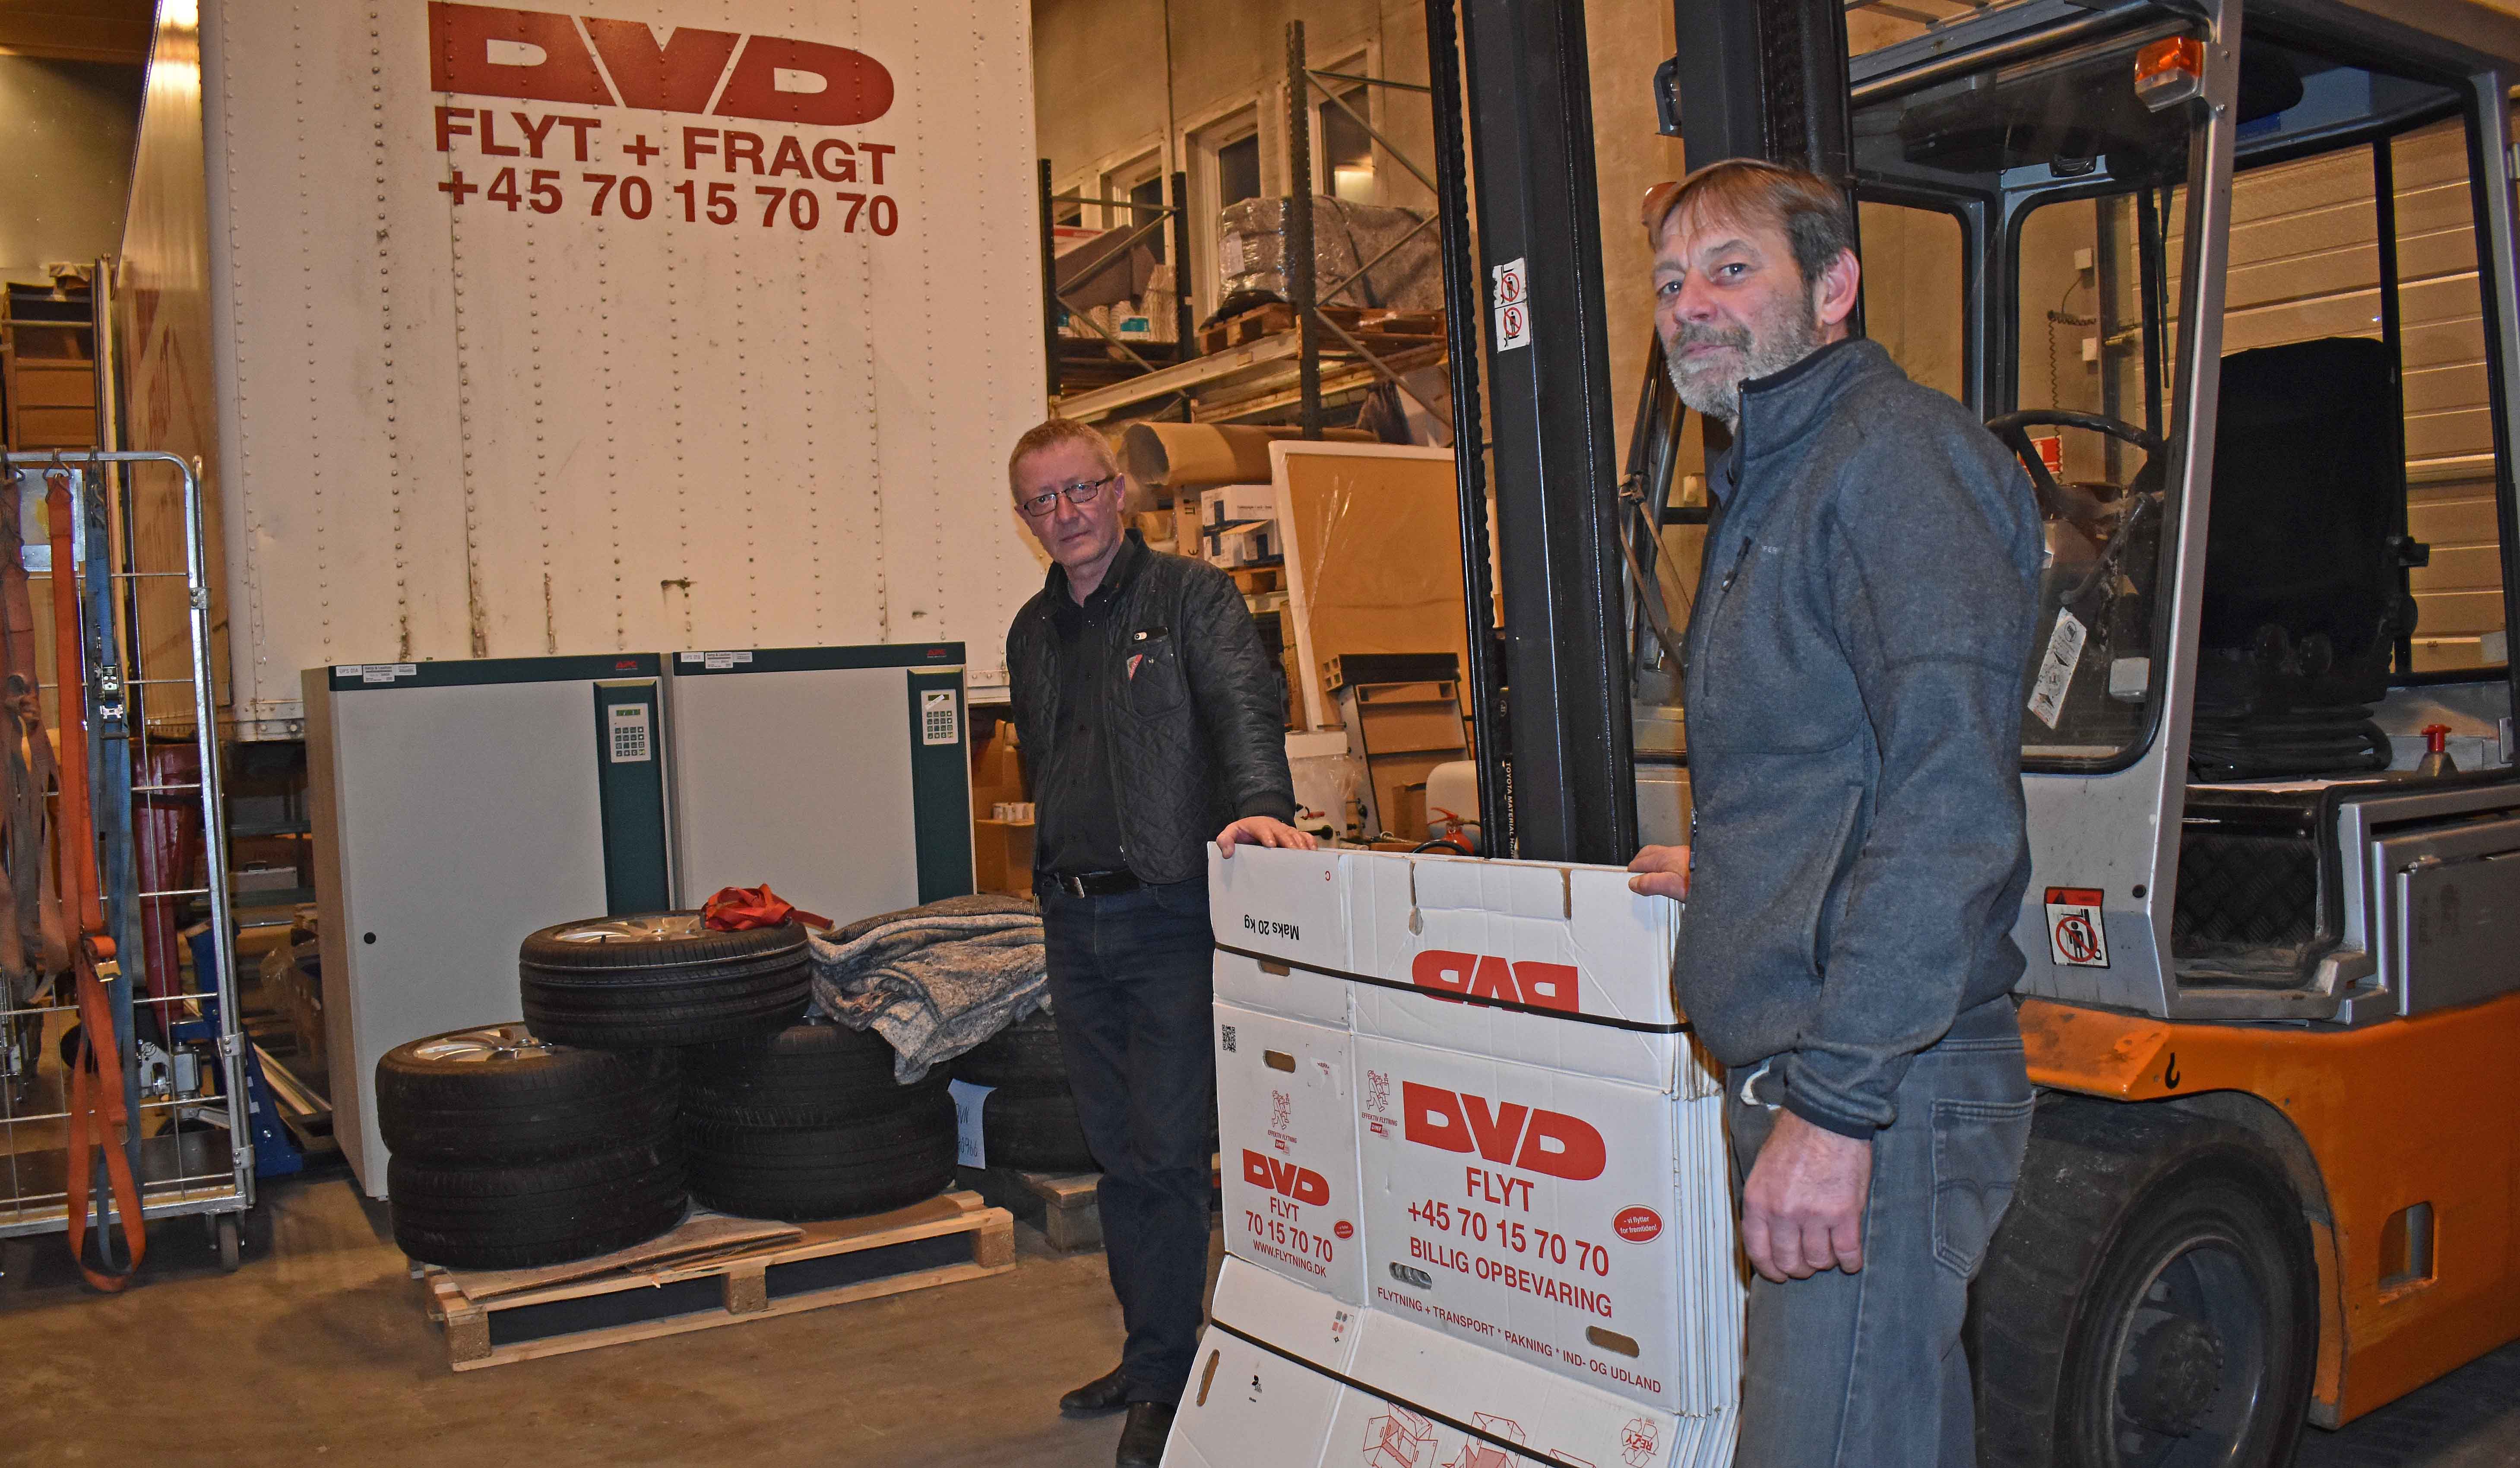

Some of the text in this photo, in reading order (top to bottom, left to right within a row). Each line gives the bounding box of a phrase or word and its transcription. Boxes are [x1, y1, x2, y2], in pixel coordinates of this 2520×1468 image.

[428, 0, 894, 126] DVD
[435, 106, 895, 184] FLYT + FRAGT
[439, 168, 898, 236] +45 70 15 70 70
[1244, 914, 1299, 940] Maks 20 kg
[1412, 950, 1580, 1014] DVD
[1361, 1112, 1398, 1126] EFFEKTIV FLYTNING
[1371, 1124, 1382, 1132] DMF
[1402, 1081, 1606, 1180] DVD
[1243, 1148, 1330, 1206] DVD
[1466, 1166, 1534, 1211] FLYT
[1246, 1210, 1263, 1236] 70
[1268, 1220, 1285, 1245] 15
[1289, 1226, 1308, 1253] 70
[1313, 1235, 1333, 1262] 70
[1270, 1196, 1299, 1222] FLYT
[1629, 1224, 1657, 1233] fremtiden!
[1633, 1216, 1649, 1224] flytter
[1253, 1239, 1326, 1278] WWW.FLYTNING.DK
[1408, 1199, 1609, 1277] +45 70 15 70 70
[1410, 1237, 1612, 1318] BILLIG OPBEVARING
[1377, 1287, 1422, 1312] FLYTNING
[1425, 1306, 1431, 1314] +
[1433, 1306, 1494, 1337] TRANSPORT
[1504, 1330, 1552, 1357] PAKNING
[1563, 1350, 1586, 1367] IND-
[1589, 1359, 1607, 1376] OG
[1611, 1366, 1661, 1393] UDLAND
